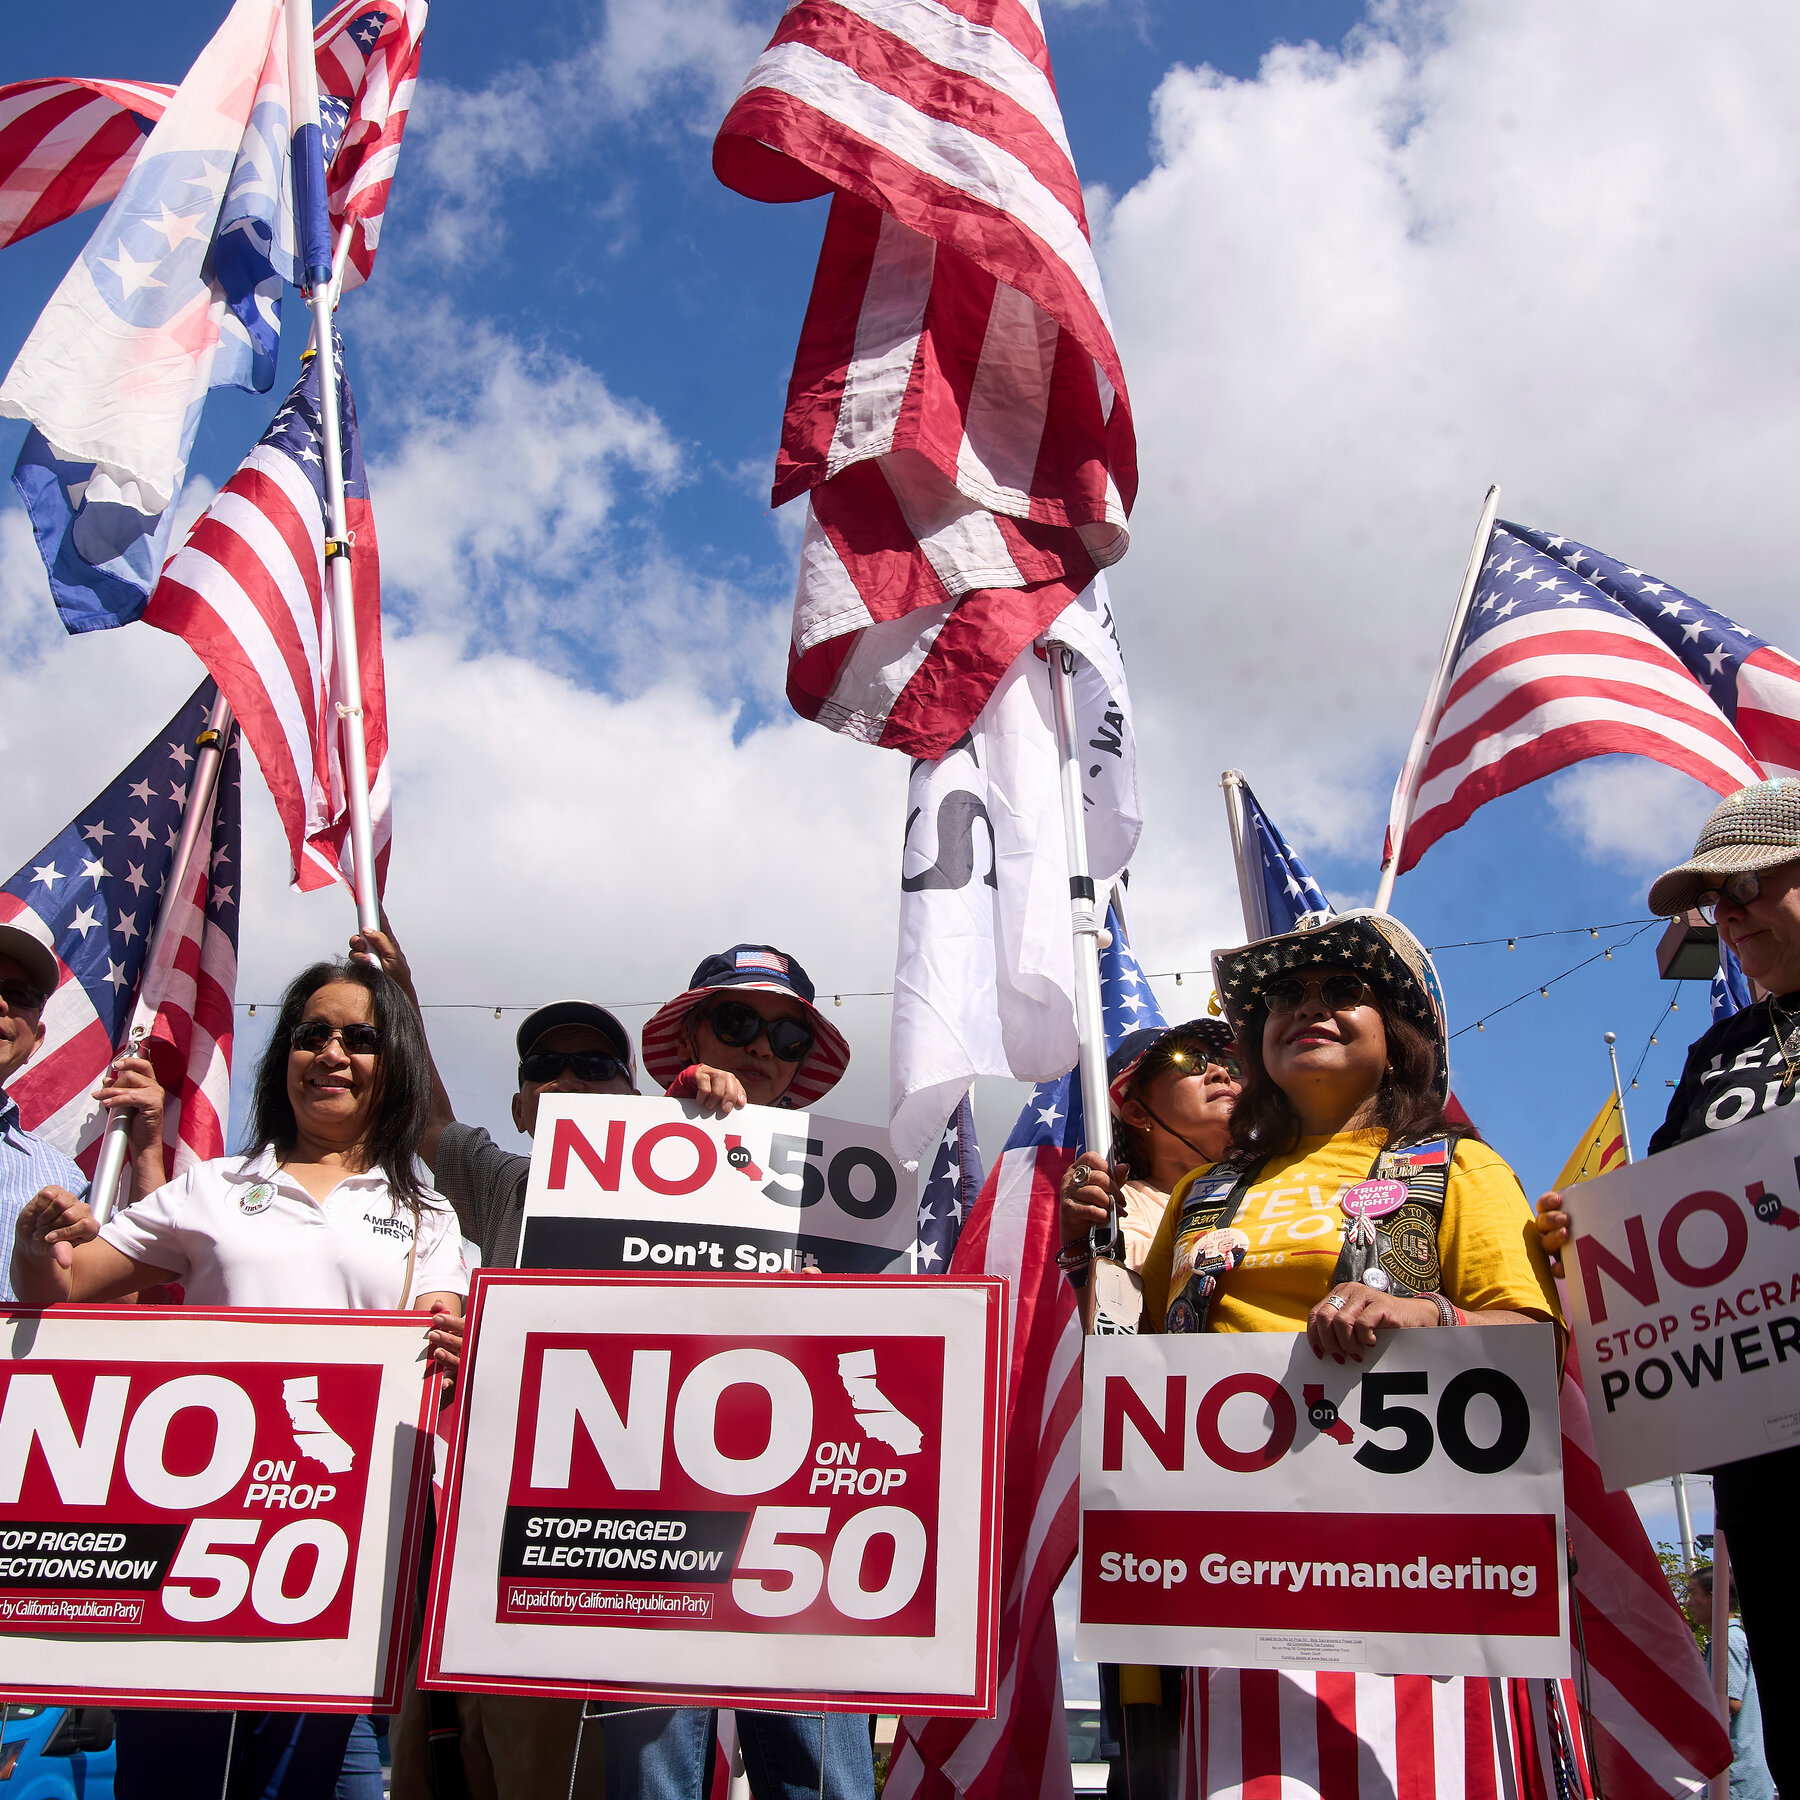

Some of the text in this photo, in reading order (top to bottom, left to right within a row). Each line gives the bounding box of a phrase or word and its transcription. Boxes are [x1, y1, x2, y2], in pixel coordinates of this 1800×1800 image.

[547, 1118, 897, 1220] NO on 50
[1350, 1197, 1395, 1208] RIGHT!
[1352, 1184, 1398, 1195] TRUMP
[1358, 1191, 1390, 1200] WAS
[1408, 1206, 1422, 1218] TO
[363, 1213, 414, 1240] AMERICA
[372, 1225, 407, 1242] FIRST
[622, 1236, 724, 1268] Don't
[1575, 1190, 1779, 1326] NO on
[1595, 1314, 1679, 1363] STOP
[1600, 1316, 1800, 1414] POWER
[529, 1348, 814, 1496] NO
[1102, 1367, 1531, 1475] NO on 50
[0, 1373, 257, 1510] NO
[813, 1441, 861, 1466] ON
[253, 1459, 296, 1482] ON
[808, 1468, 907, 1496] PROP
[243, 1484, 337, 1510] PROP
[37, 1531, 127, 1552] RIGGED
[525, 1517, 687, 1542] STOP RIGGED
[96, 1559, 158, 1580] NOW
[522, 1545, 724, 1571] ELECTIONS NOW
[731, 1505, 928, 1620] 50
[162, 1518, 350, 1625] 50
[1099, 1551, 1537, 1598] Stop Gerrymandering
[2, 1599, 17, 1619] by
[16, 1600, 59, 1616] California
[59, 1600, 114, 1620] Republican
[113, 1602, 141, 1621] Party
[511, 1590, 711, 1616] Ad paid for by California Republican Party
